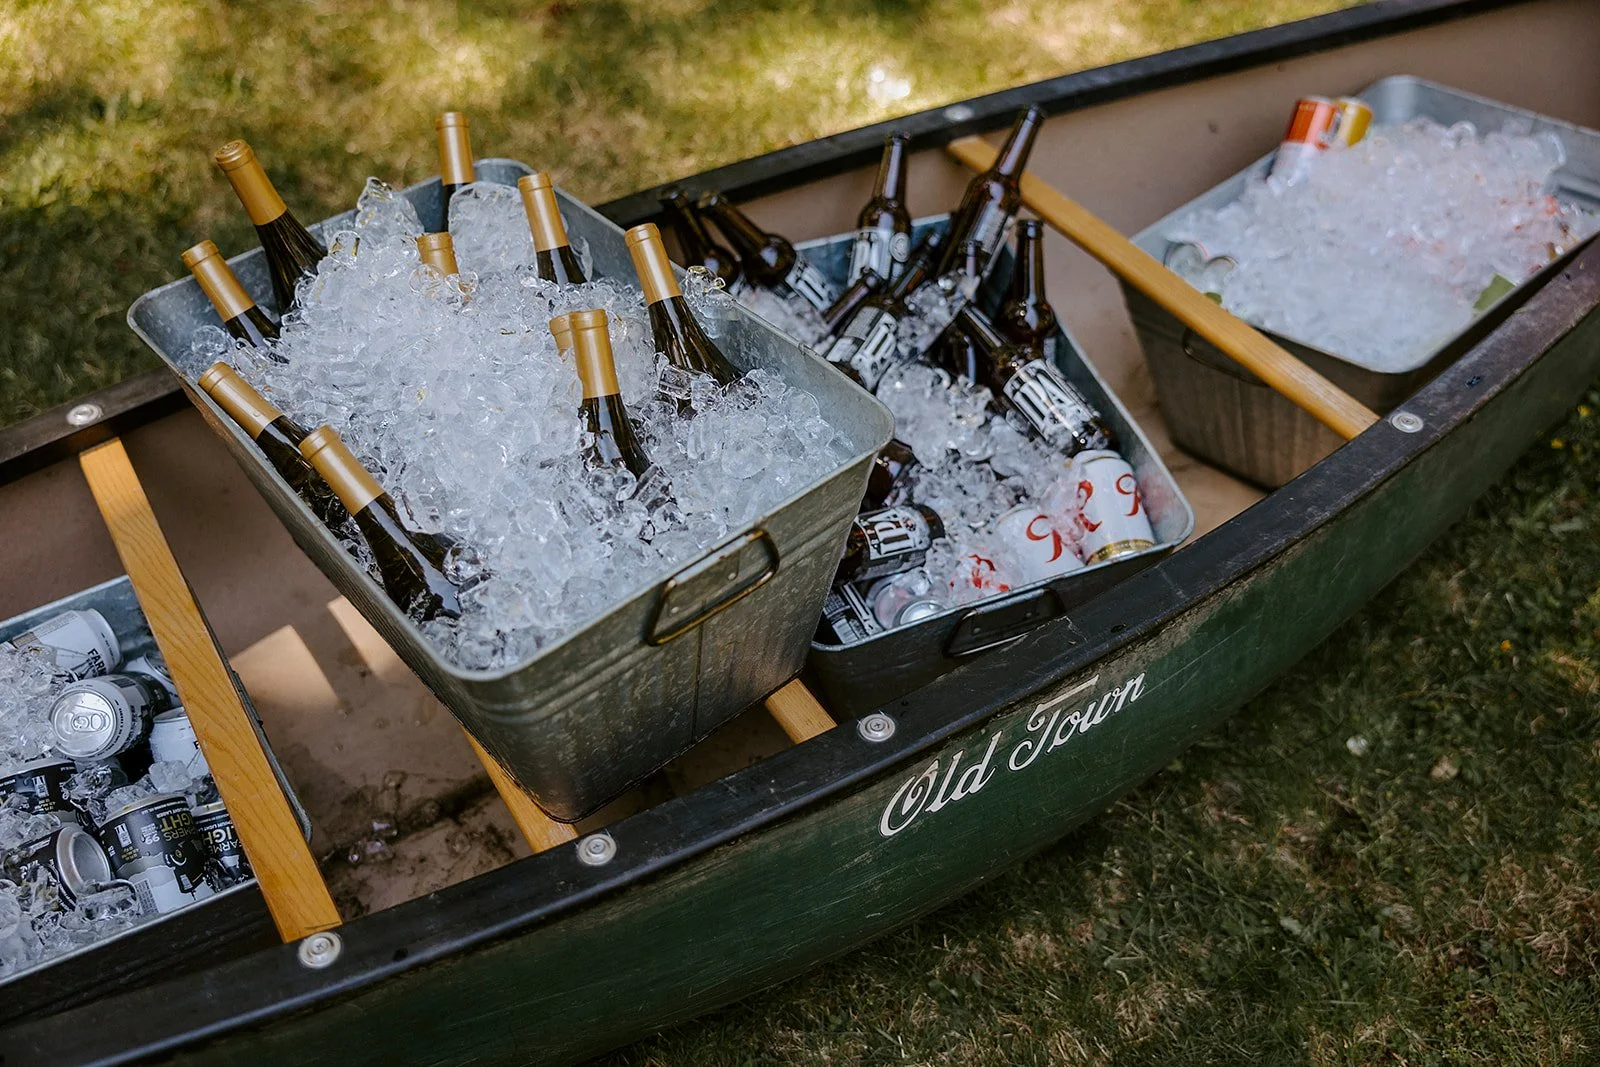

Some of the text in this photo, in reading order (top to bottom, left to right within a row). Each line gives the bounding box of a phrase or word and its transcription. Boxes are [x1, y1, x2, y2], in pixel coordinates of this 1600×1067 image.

[879, 672, 1146, 837] Old Town
[161, 812, 191, 832] GHT
[144, 833, 160, 845] 99
[201, 825, 237, 846] IGH
